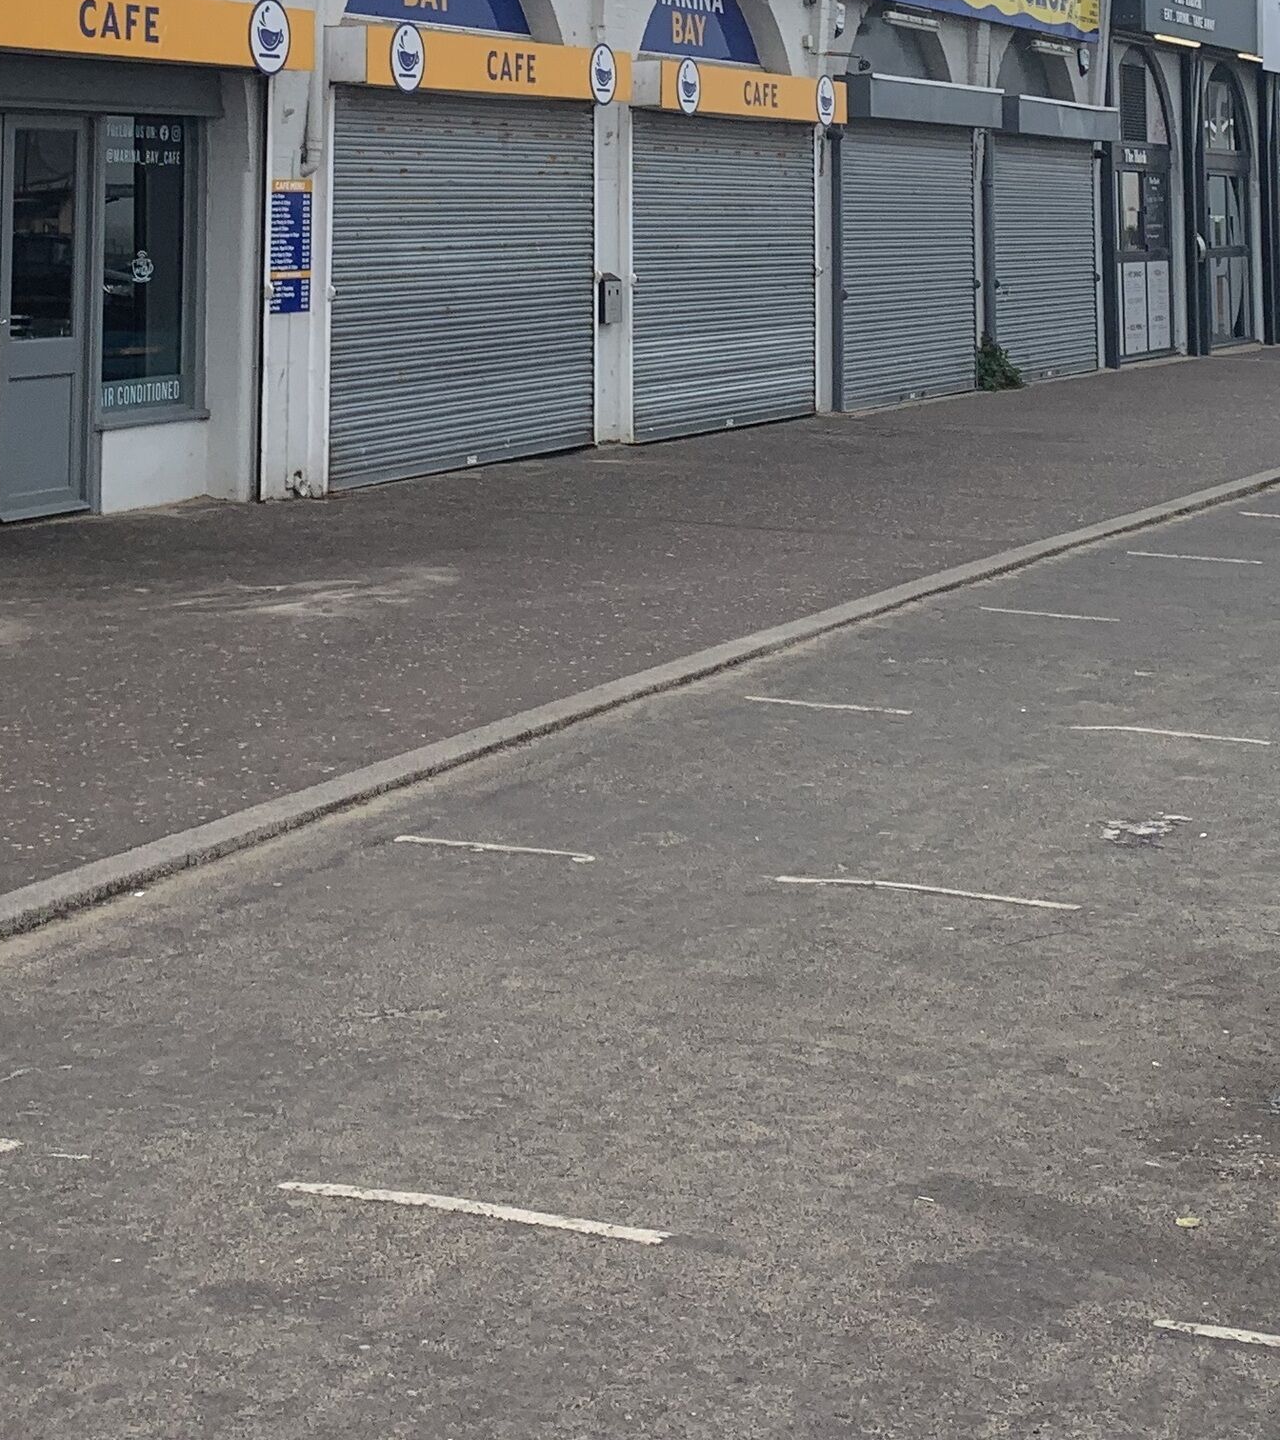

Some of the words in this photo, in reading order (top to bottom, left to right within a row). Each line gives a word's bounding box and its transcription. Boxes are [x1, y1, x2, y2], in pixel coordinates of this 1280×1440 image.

[672, 11, 707, 47] BAY
[487, 50, 537, 83] CAFE
[743, 80, 779, 109] CAFE
[117, 380, 180, 406] CONDITIONED
